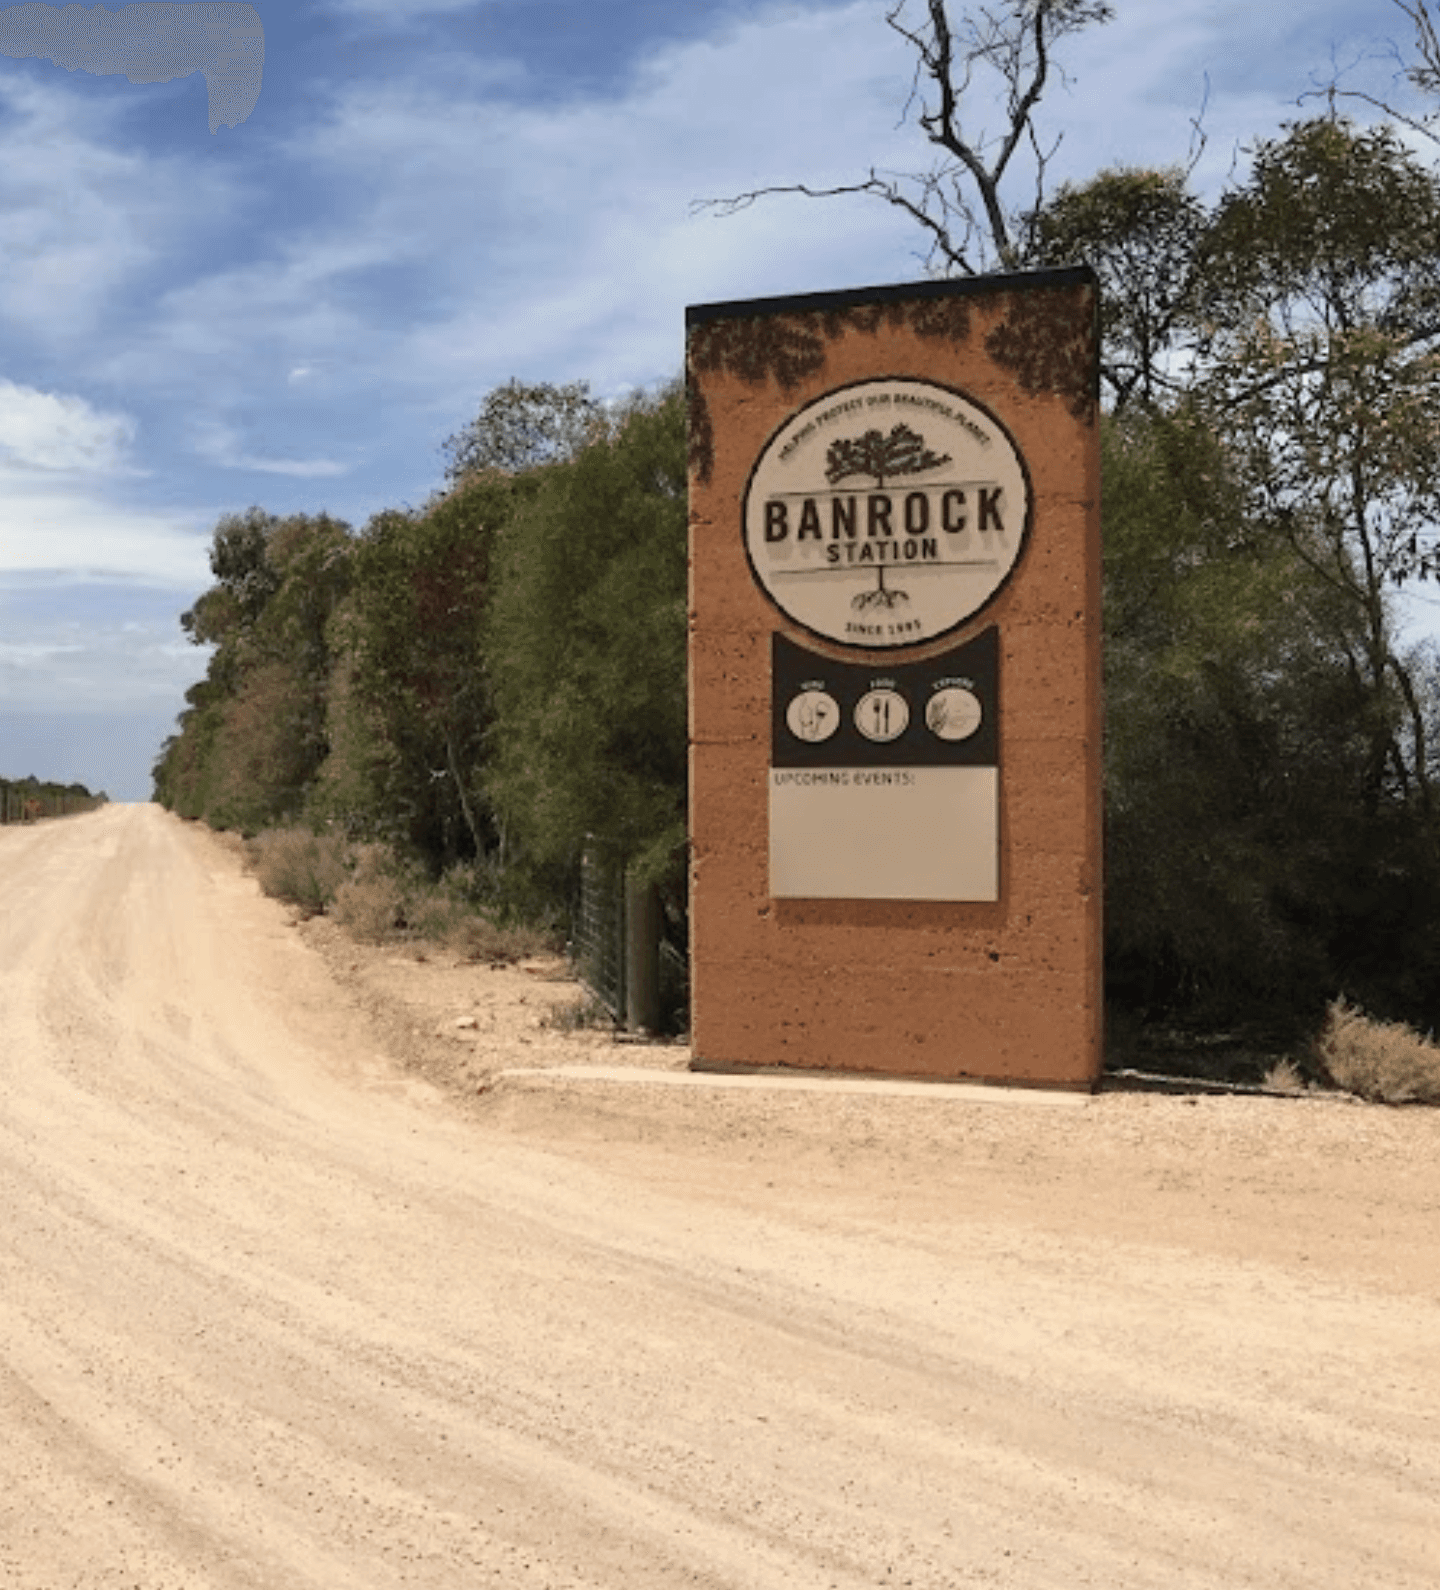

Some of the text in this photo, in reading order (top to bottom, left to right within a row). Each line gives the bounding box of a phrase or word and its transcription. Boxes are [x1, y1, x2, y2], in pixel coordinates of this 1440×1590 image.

[763, 487, 1005, 543] BANROCK
[826, 538, 938, 563] STATION
[774, 771, 916, 786] UPCOMING EVENTS:
